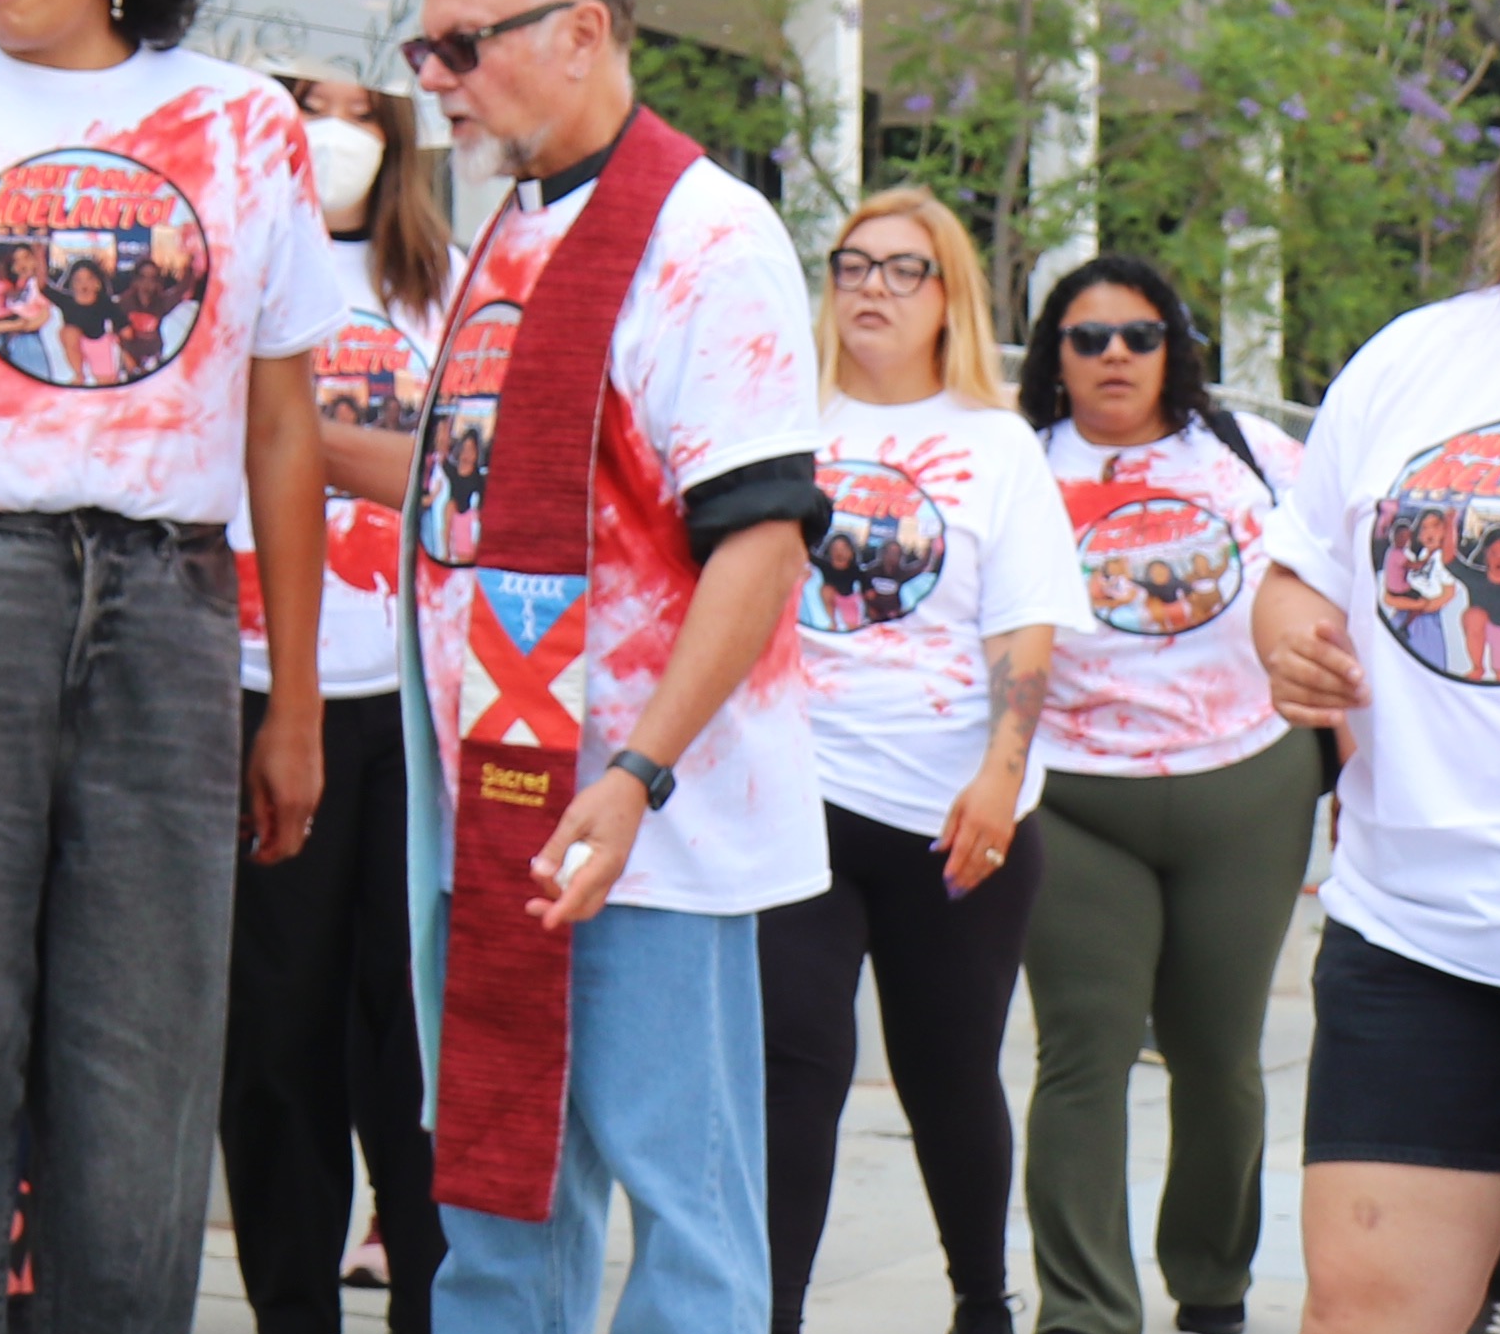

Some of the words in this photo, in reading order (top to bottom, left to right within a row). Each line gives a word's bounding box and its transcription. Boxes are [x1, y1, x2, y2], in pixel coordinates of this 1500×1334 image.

[1, 164, 78, 191] SHUT
[79, 166, 168, 195] DOWN
[482, 762, 549, 794] Sacred
